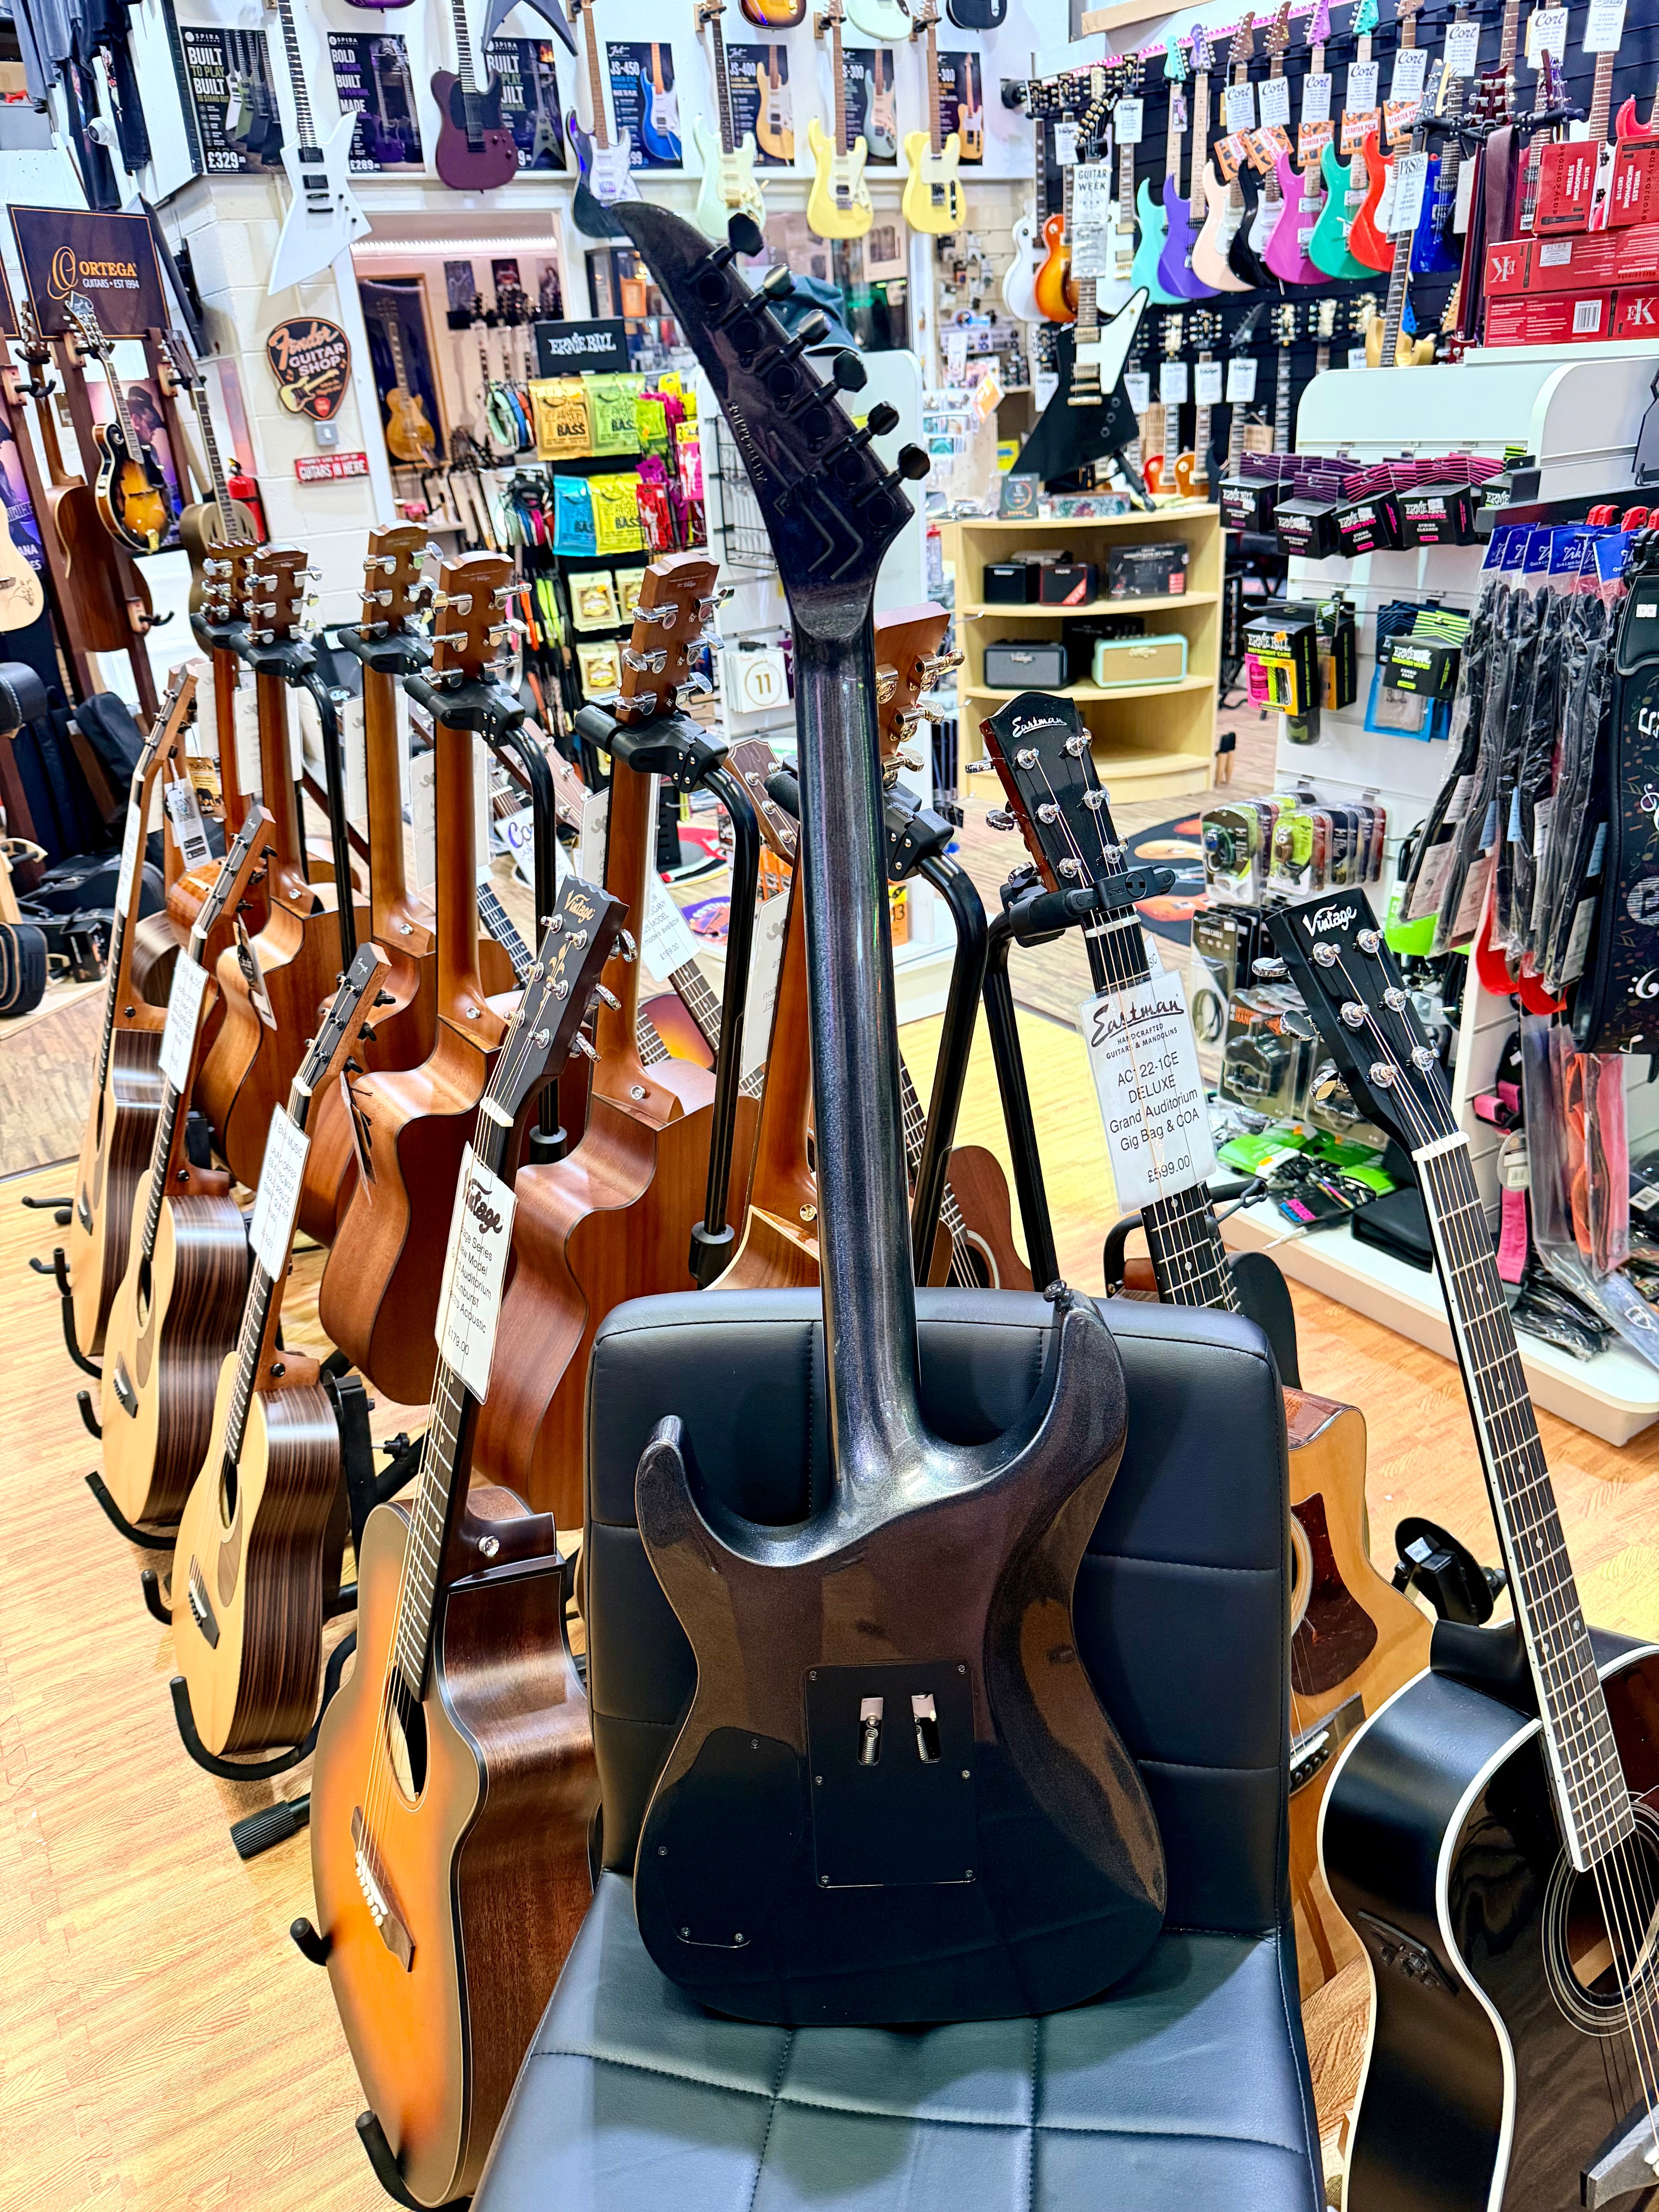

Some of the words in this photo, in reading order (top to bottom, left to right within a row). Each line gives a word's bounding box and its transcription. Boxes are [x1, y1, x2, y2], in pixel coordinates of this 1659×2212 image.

[1535, 12, 1565, 27] Cort
[1449, 26, 1477, 40] Cort
[187, 47, 222, 65] BUILT
[332, 50, 356, 63] BOLD
[1398, 52, 1424, 64] Cort
[191, 65, 203, 77] TO
[204, 66, 225, 77] PLAY
[610, 61, 639, 76] JS-450
[730, 62, 756, 76] JS-400
[842, 64, 864, 79] S-300
[1351, 65, 1375, 77] Cort
[193, 78, 225, 95] BUILT
[336, 74, 361, 88] BUILT
[1262, 81, 1286, 96] Cort
[1306, 77, 1329, 88] Cort
[501, 86, 523, 104] UILT
[1228, 87, 1250, 100] Cort
[340, 99, 366, 112] MADE
[1389, 113, 1407, 125] STARTER
[1345, 124, 1364, 134] STARTER
[1365, 123, 1377, 132] PACK
[1301, 138, 1320, 147] STARTER
[1320, 136, 1331, 144] PACK
[1078, 169, 1108, 180] GUITAR
[1566, 165, 1575, 196] WIRELESS
[1573, 158, 1583, 201] MICROPHONE
[1078, 181, 1106, 191] WEEK
[1623, 165, 1634, 209] MICROPHONE
[1632, 170, 1641, 201] WIRELESS
[79, 261, 137, 276] ORTEGA
[82, 278, 110, 288] GUITARS
[113, 279, 124, 289] EST
[268, 322, 339, 371] Fender
[548, 332, 586, 355] ERNIE
[289, 342, 345, 368] GUITAR
[299, 356, 341, 376] SHOP
[557, 424, 585, 436] BASS
[333, 464, 342, 478] IN
[1223, 488, 1240, 501] ERNIE
[1486, 491, 1510, 505] ERNIE
[1405, 500, 1427, 515] ERNIE
[1338, 511, 1358, 528] ERNIE
[1341, 523, 1361, 534] WONDER
[1247, 632, 1271, 648] ERNIE
[1247, 647, 1276, 656] INSTRUMENT
[1392, 656, 1413, 666] WONDER
[1414, 661, 1431, 670] WIPES
[756, 674, 773, 694] 11
[1012, 716, 1067, 738] Eastman
[564, 890, 596, 924] Vintage
[892, 904, 905, 921] 13
[652, 912, 669, 927] MODEL
[1302, 903, 1357, 937] Vintage
[645, 932, 661, 946] models
[661, 917, 680, 934] available
[1091, 999, 1184, 1048] Eastman
[1117, 1023, 1164, 1045] HANDCRAFTED
[1106, 1044, 1133, 1060] GUITARS
[1142, 1027, 1178, 1047] MANDOLINS
[1118, 1051, 1179, 1087] AC22-1CE
[1129, 1074, 1176, 1103] DELUXE
[1109, 1113, 1142, 1133] Grand
[1146, 1089, 1198, 1120] Auditorium
[1121, 1134, 1139, 1151] Gig
[1141, 1125, 1164, 1144] Bag
[1167, 1120, 1175, 1132] &
[1177, 1108, 1200, 1128] COA
[288, 1136, 304, 1159] MUSIC
[1147, 1155, 1190, 1183] £599.00
[462, 1167, 503, 1234] Vintage
[471, 1237, 492, 1261] Series
[468, 1252, 488, 1276] Model
[455, 1276, 479, 1308] Sunburst
[460, 1267, 492, 1300] Auditorium
[460, 1305, 486, 1334] Acoustic
[448, 1326, 469, 1355] £179.00
